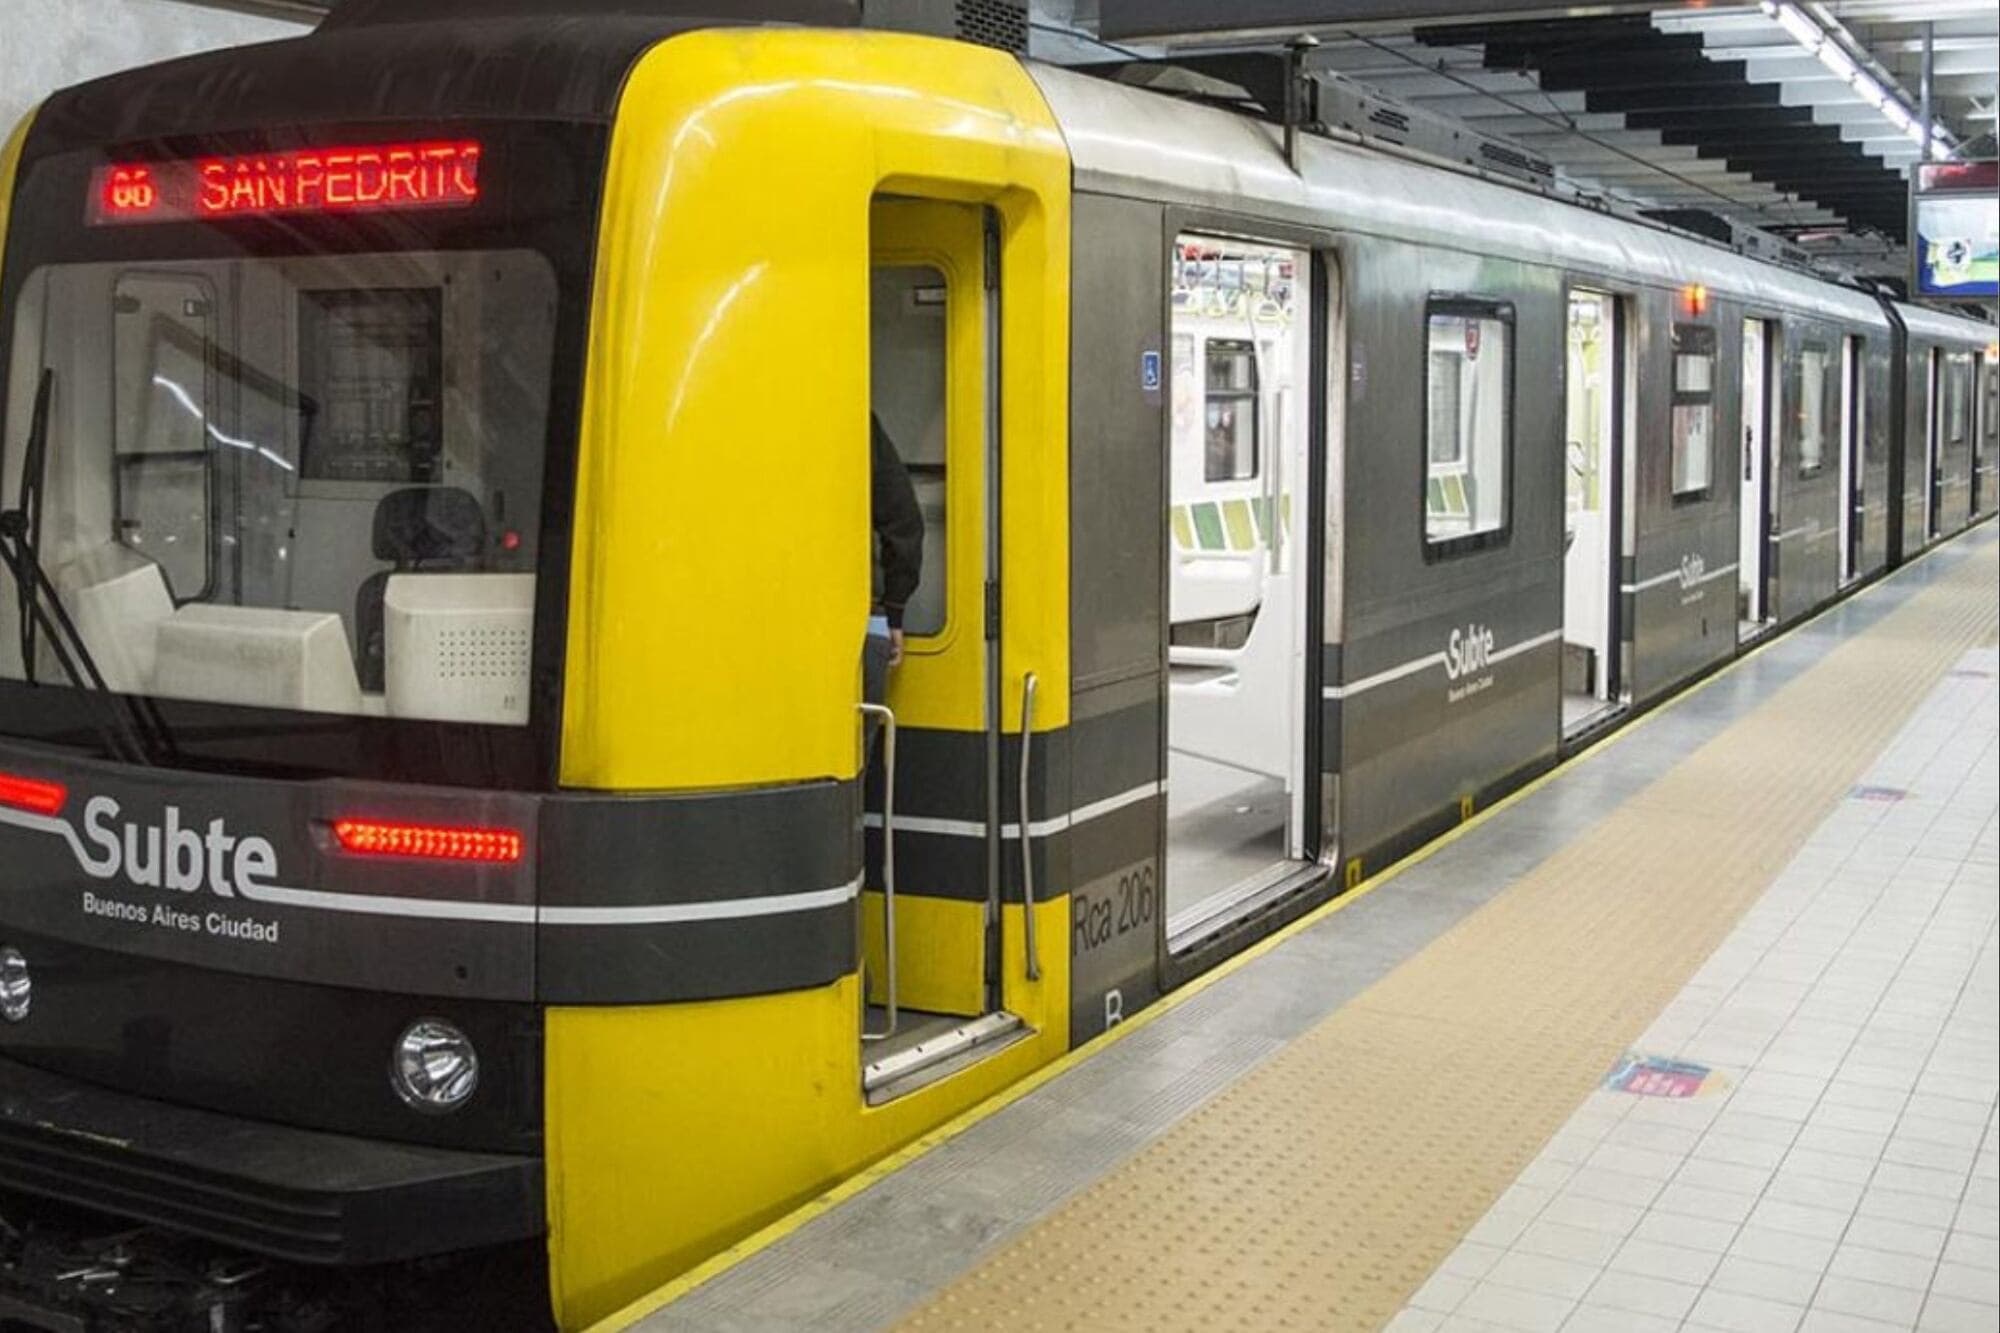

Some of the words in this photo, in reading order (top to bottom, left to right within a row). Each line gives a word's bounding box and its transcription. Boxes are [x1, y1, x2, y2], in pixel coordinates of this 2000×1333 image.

[201, 162, 287, 210] SAN
[1444, 623, 1494, 680] Subte
[82, 795, 278, 901] Subte
[83, 892, 147, 922] Buenos
[151, 905, 201, 931] Aires
[205, 912, 279, 942] Ciudad
[1074, 894, 1112, 957] Rca
[1118, 865, 1153, 934] 206
